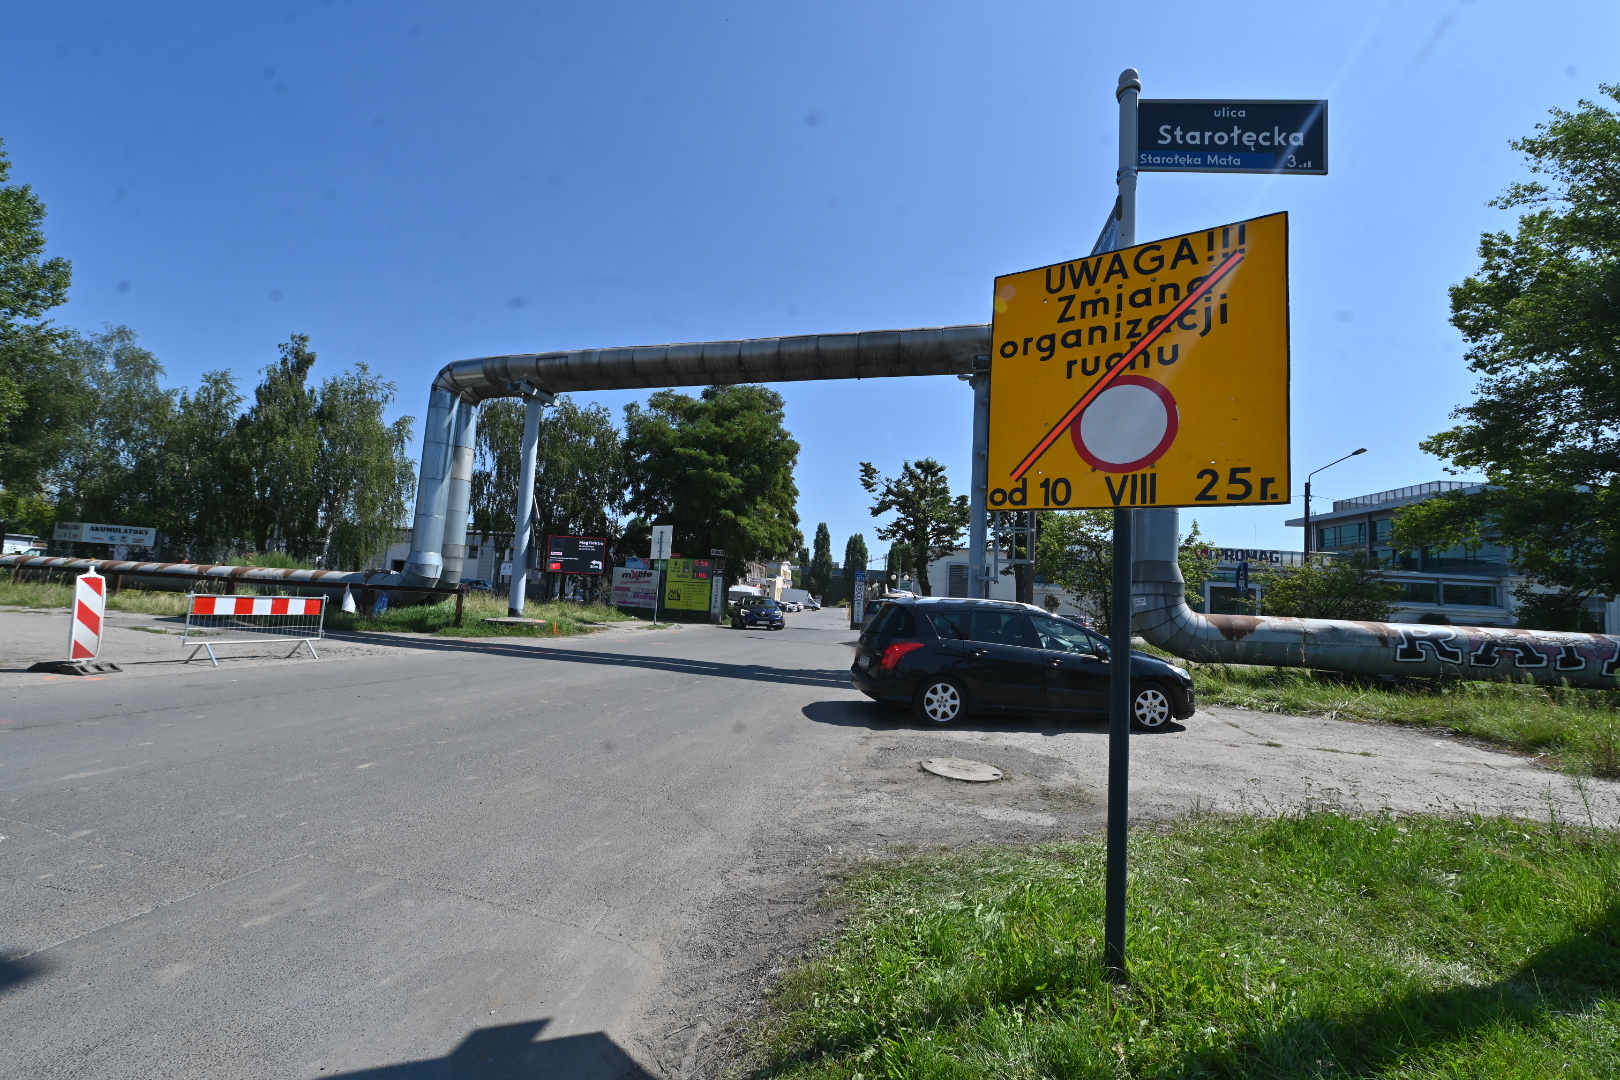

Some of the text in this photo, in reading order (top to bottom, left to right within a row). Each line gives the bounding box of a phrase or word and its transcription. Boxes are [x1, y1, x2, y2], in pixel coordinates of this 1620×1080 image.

[1213, 107, 1246, 118] ulica
[1157, 124, 1305, 151] Starołęcka
[1139, 153, 1202, 167] Starołęka
[1206, 154, 1241, 166] Mała
[1045, 223, 1246, 294] UWAGA!!!
[1057, 273, 1213, 324] Zmiana
[1000, 292, 1228, 362] organizacji
[1066, 340, 1179, 380] ruchu
[989, 477, 1028, 506] od
[1039, 477, 1072, 507] 10
[1104, 472, 1157, 506] VIII
[89, 525, 150, 536] AKUMULATORY
[1215, 548, 1280, 564] PROMAG
